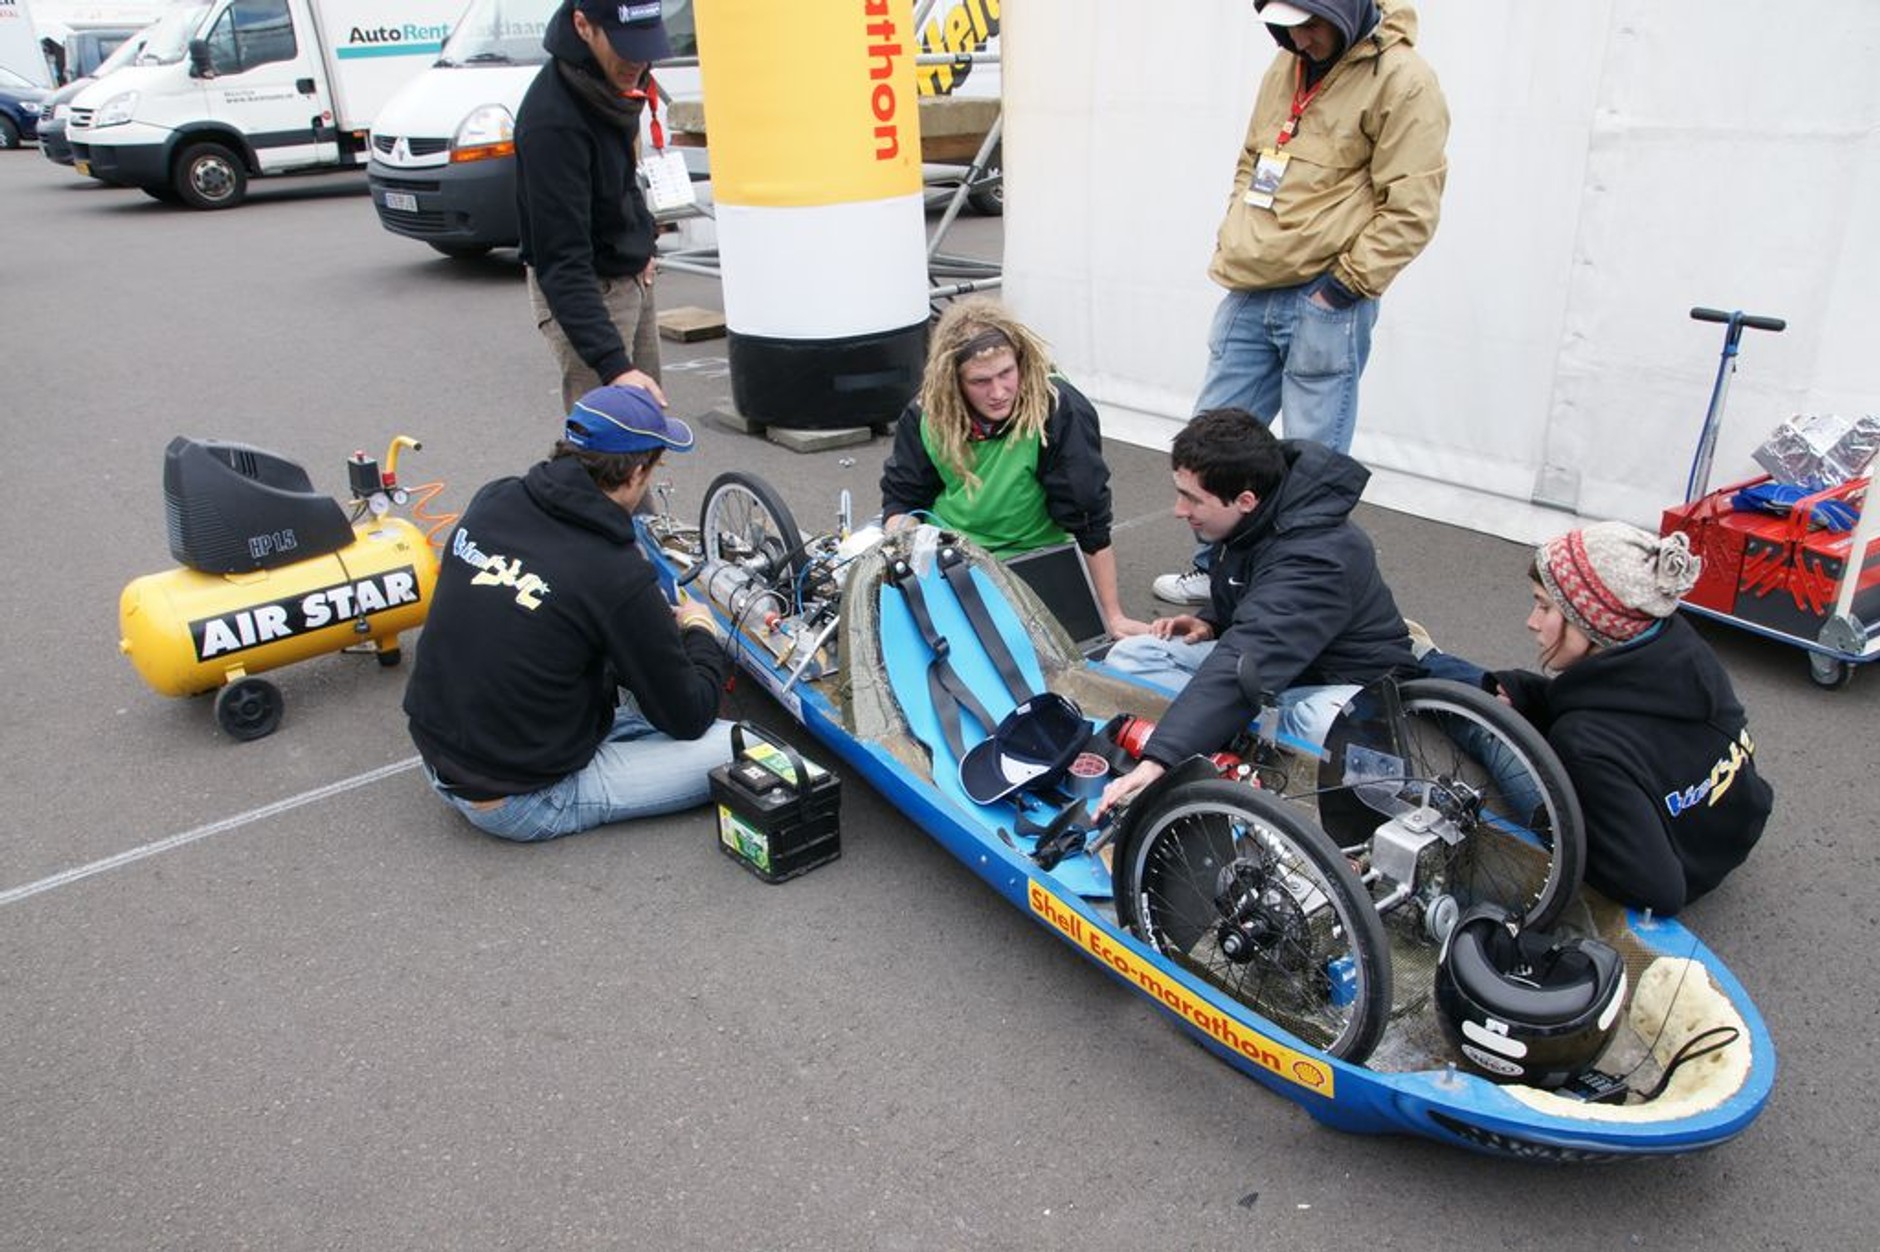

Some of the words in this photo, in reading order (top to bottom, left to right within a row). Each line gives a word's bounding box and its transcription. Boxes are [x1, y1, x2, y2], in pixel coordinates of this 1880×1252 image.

[350, 23, 449, 43] AutoRent
[248, 534, 272, 559] HP
[202, 605, 293, 658] AIR
[302, 571, 418, 628] STAR
[1031, 888, 1083, 942] Shell
[1089, 931, 1282, 1071] Eco-marathon
